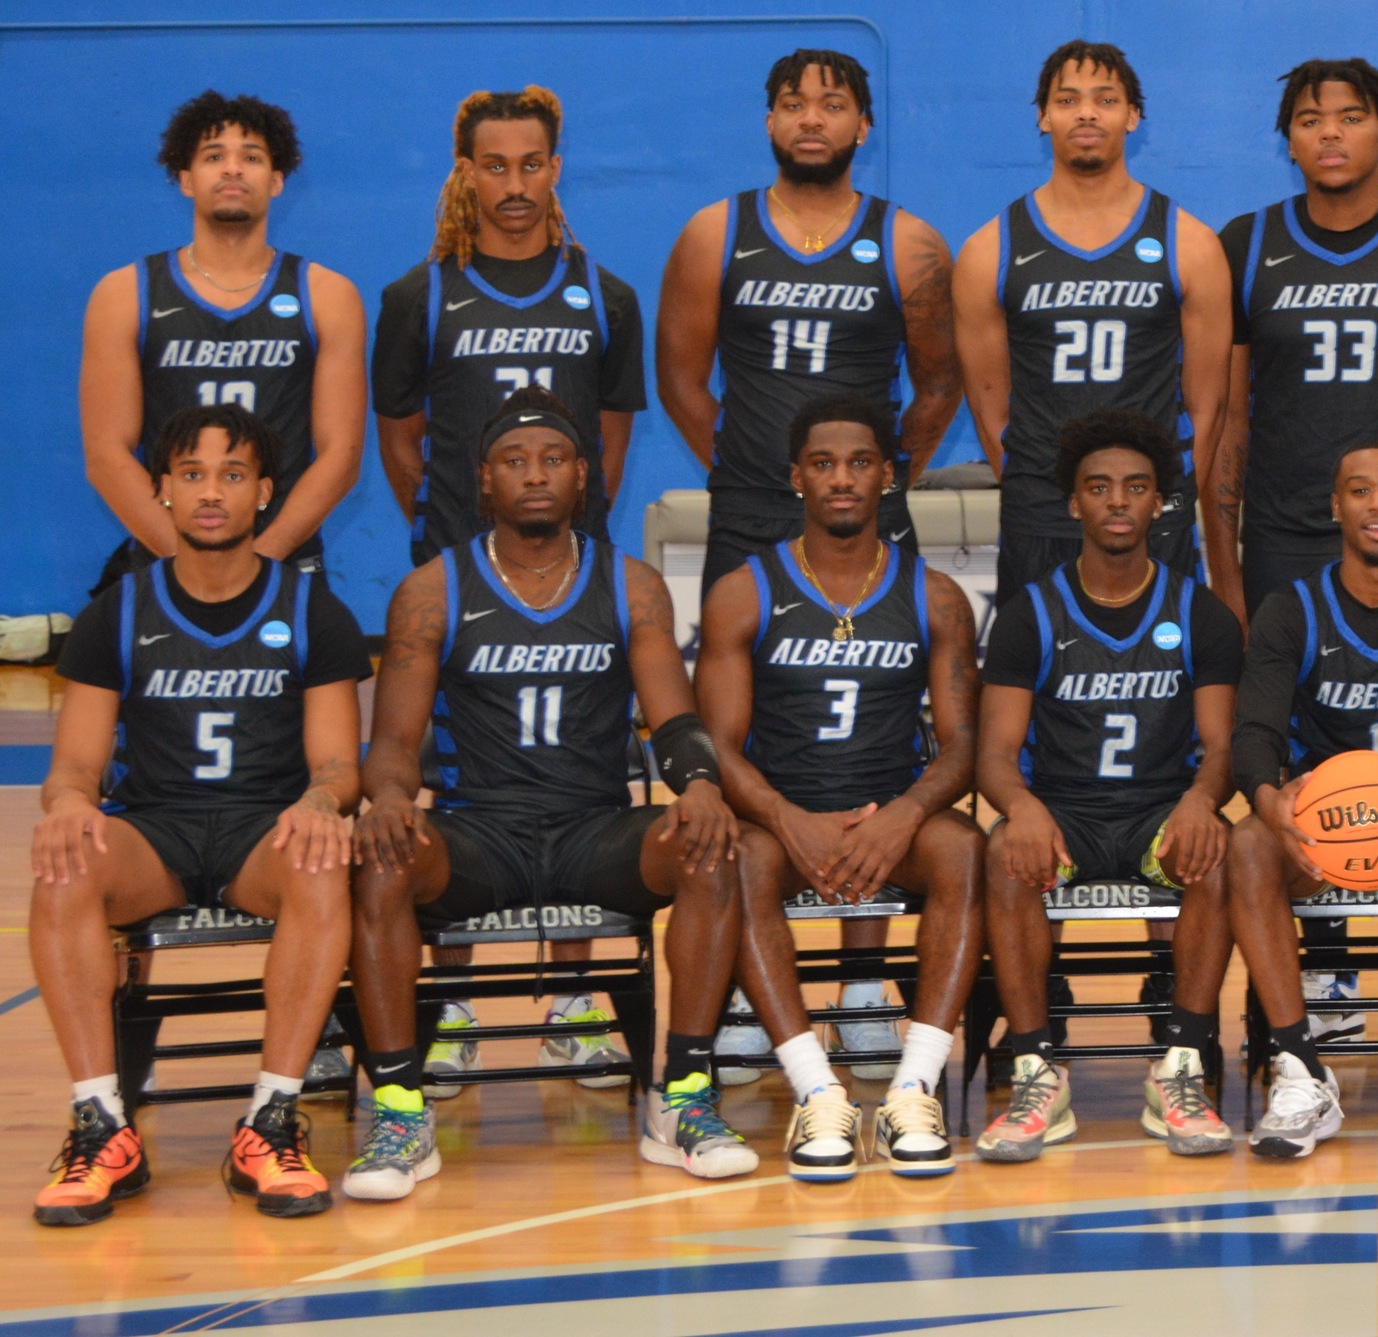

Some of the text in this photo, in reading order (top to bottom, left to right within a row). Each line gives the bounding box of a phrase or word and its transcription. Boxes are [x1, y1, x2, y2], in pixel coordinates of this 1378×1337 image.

[735, 278, 881, 313] ALBERTUS
[1021, 279, 1165, 313] ALBERTUS
[159, 338, 301, 369] ALBERTUS
[453, 326, 594, 359] ALBERTUS
[770, 318, 832, 374] 14
[1052, 318, 1128, 384] 20
[1302, 318, 1378, 383] 33
[467, 643, 616, 674] ALBERTUS
[769, 636, 920, 670] ALBERTUS
[143, 667, 291, 699] ALBERTUS
[1055, 668, 1184, 702] ALBERTUS
[518, 685, 563, 748] 11
[817, 678, 861, 742] 3
[194, 711, 236, 780] 5
[1098, 713, 1138, 779] 2
[1042, 884, 1151, 909] ALCONS
